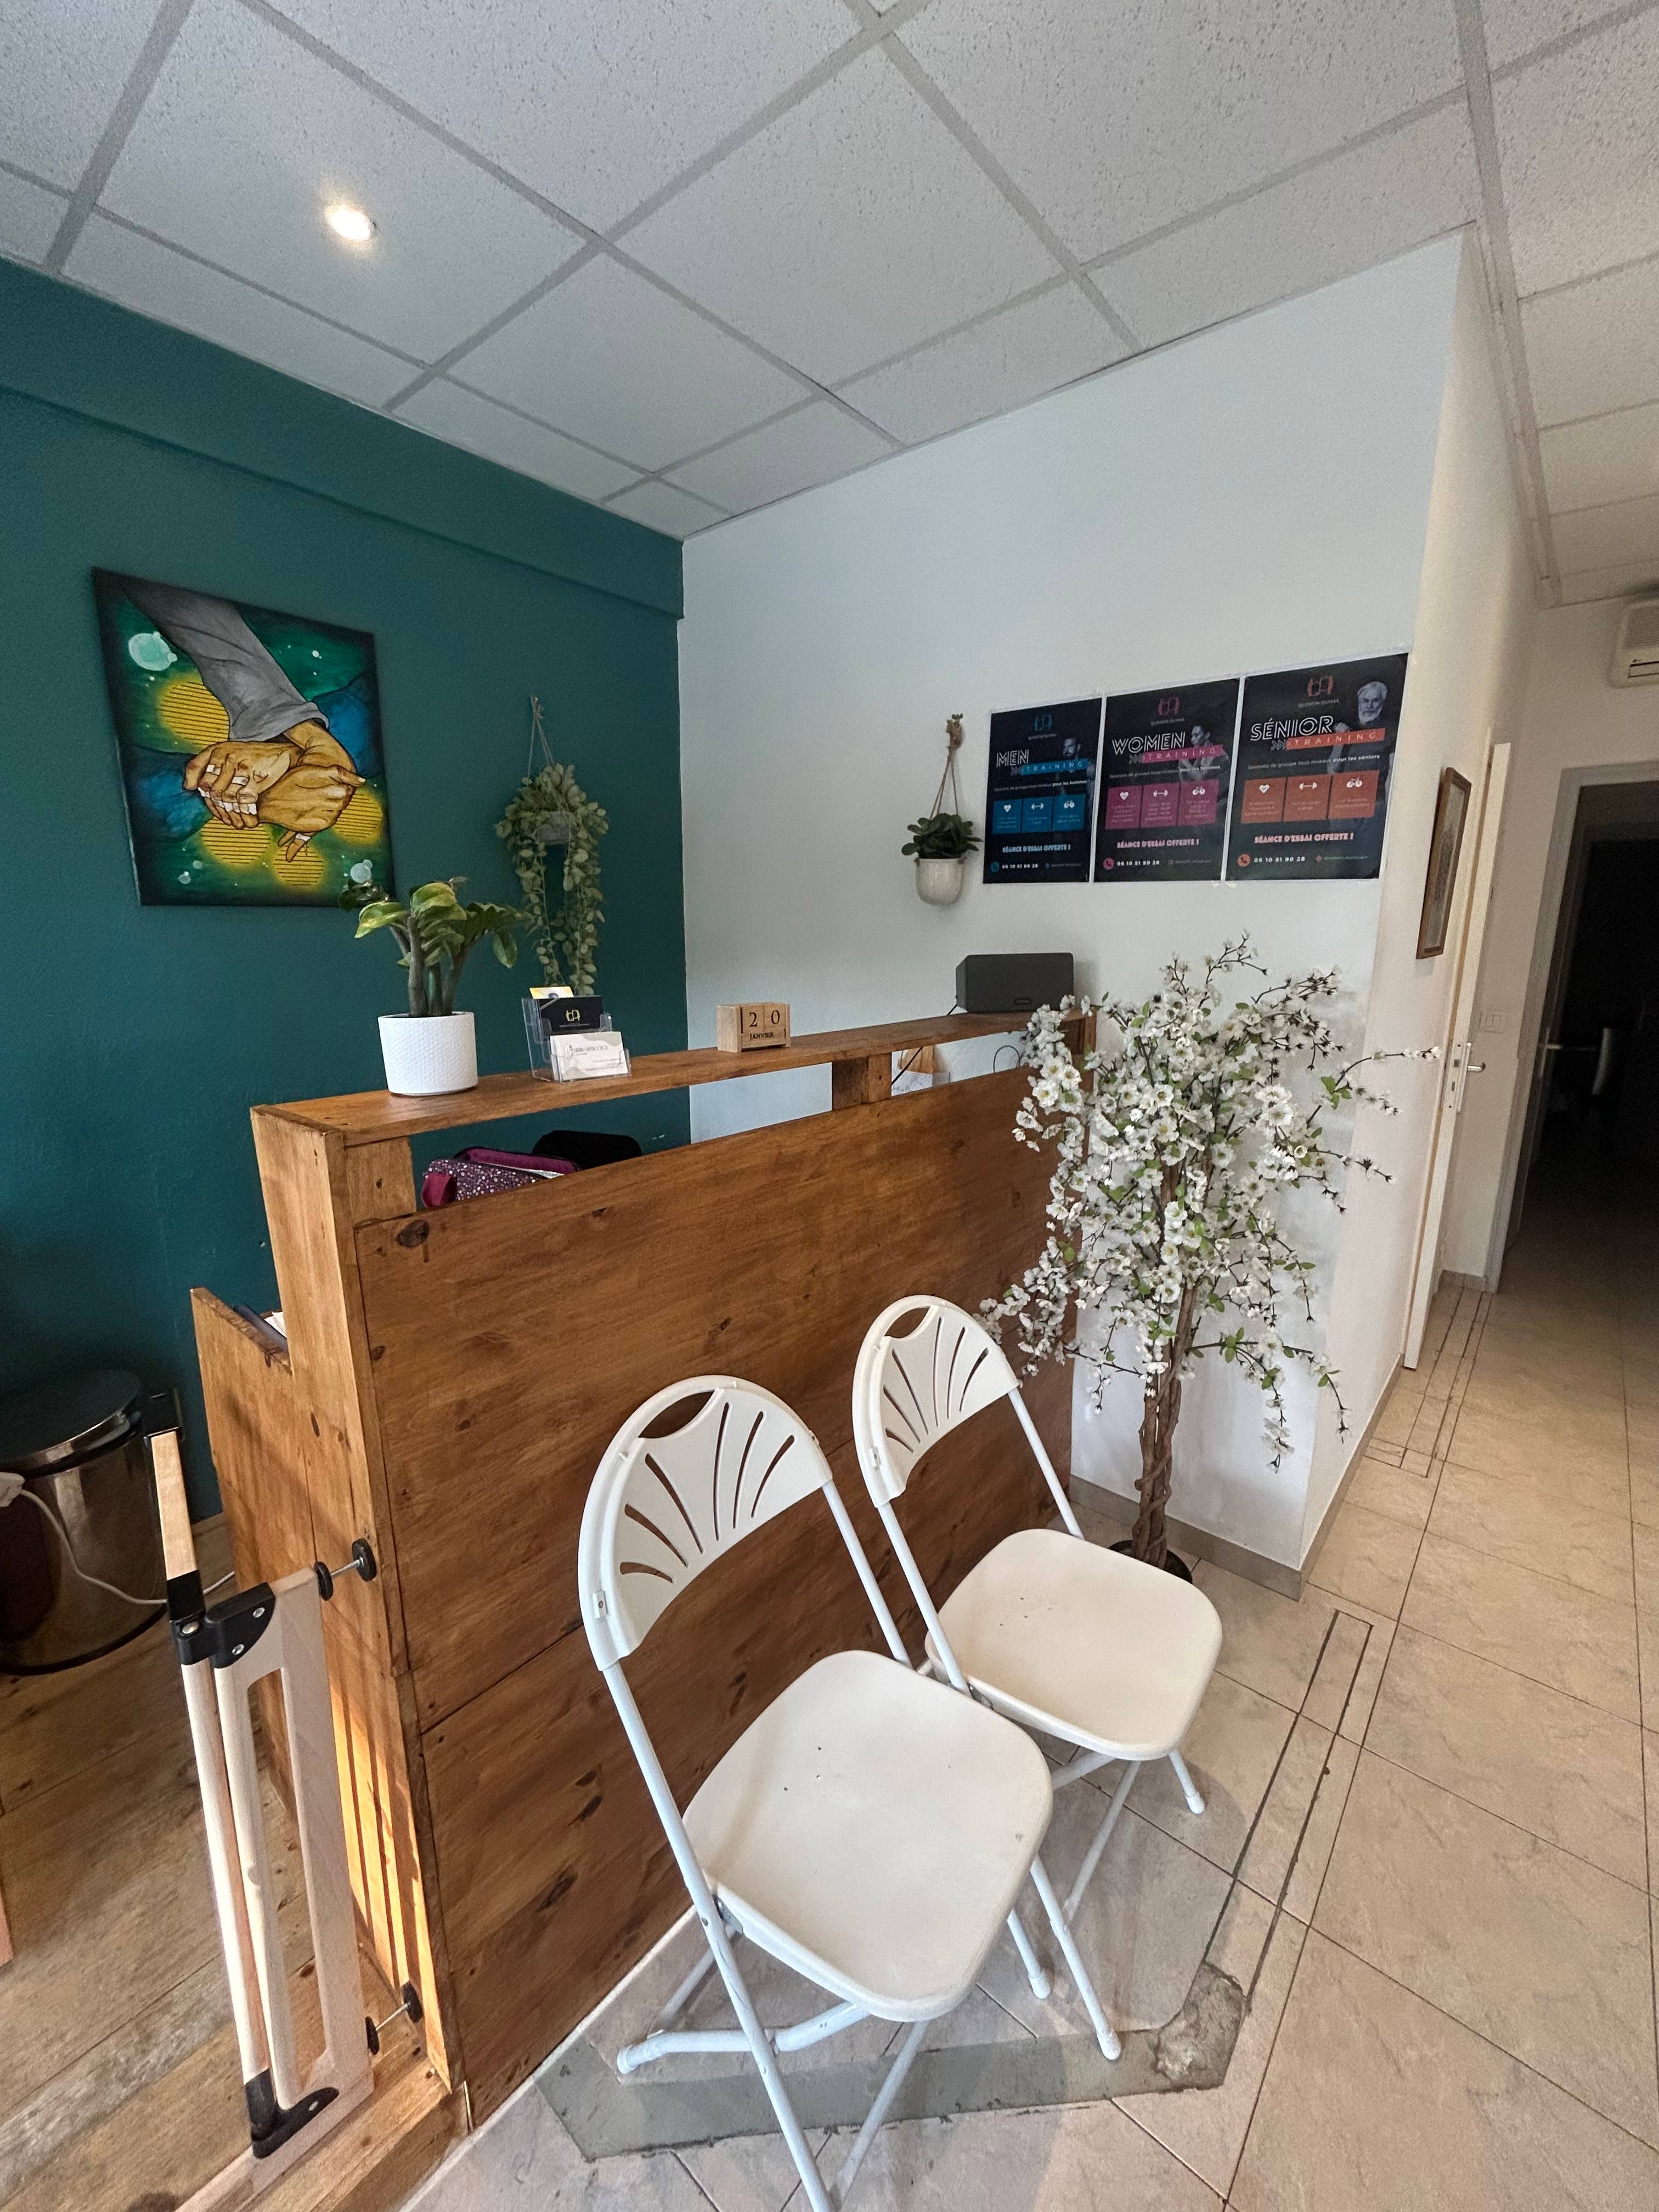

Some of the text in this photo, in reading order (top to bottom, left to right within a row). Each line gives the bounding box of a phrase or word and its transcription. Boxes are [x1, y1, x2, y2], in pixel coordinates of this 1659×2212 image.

[1250, 715, 1334, 741] SÉNIOR
[1112, 731, 1186, 755] WOMEN
[1295, 732, 1377, 746] TRAINING
[996, 749, 1029, 768] MEN
[1148, 748, 1216, 760] TRAINING
[1027, 761, 1083, 771] TRAINING
[1117, 840, 1140, 848] SÉANCE
[1254, 834, 1283, 843] SÉANCE
[1314, 833, 1348, 841] OFFERTE
[749, 1032, 774, 1041] JANVIER
